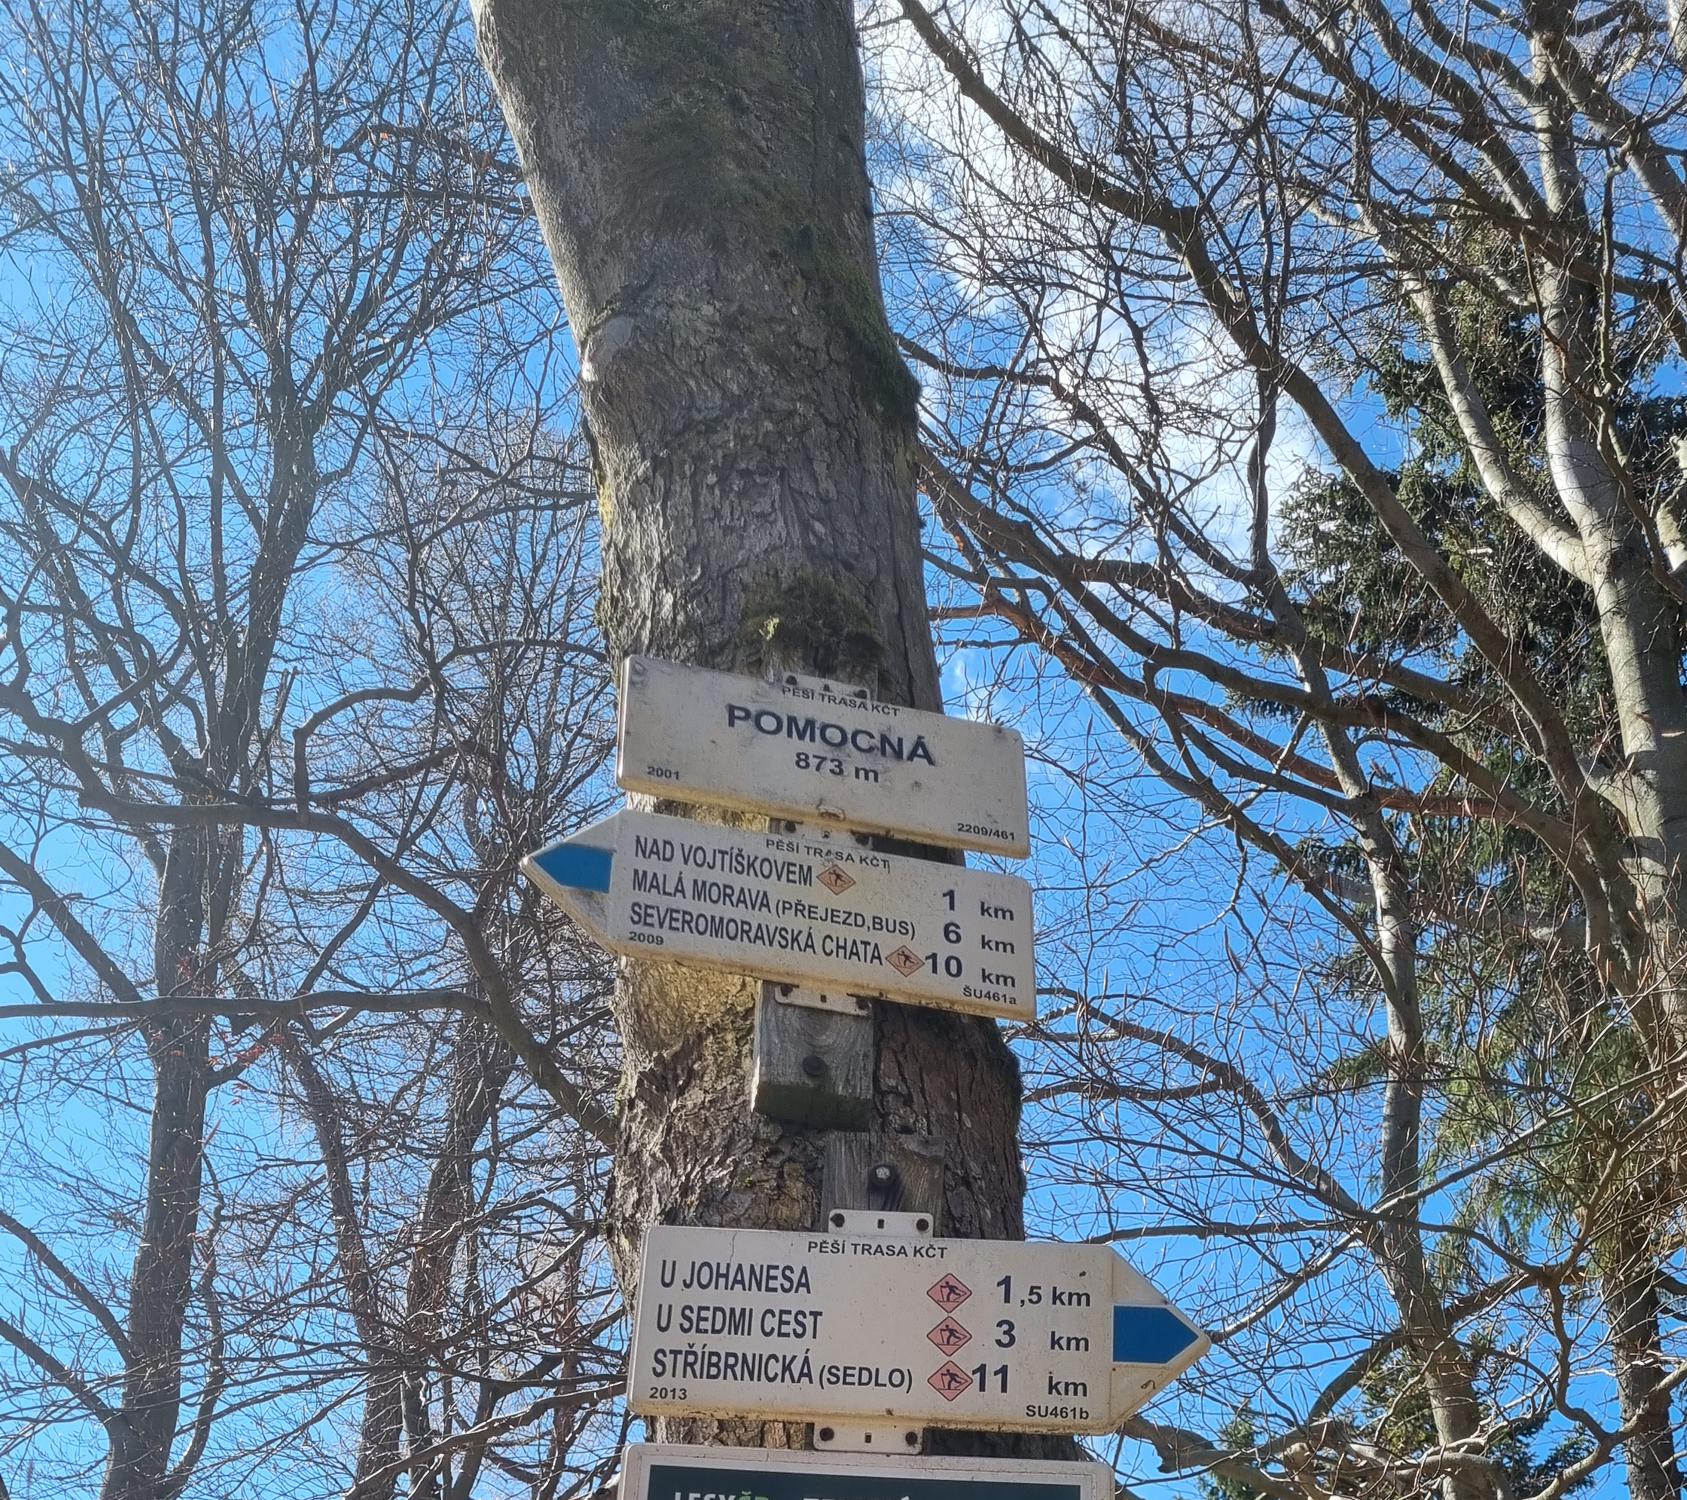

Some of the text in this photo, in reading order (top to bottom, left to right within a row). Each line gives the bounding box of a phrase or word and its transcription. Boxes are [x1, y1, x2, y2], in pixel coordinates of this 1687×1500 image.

[818, 691, 868, 713] TRASA
[870, 700, 900, 717] KČT
[726, 703, 936, 766] POMOCNÁ
[647, 766, 680, 780] 2001
[795, 752, 880, 783] 873 m
[957, 823, 1015, 841] 2209/461
[766, 838, 889, 870] PĚŠÍ TRASA KČT
[634, 835, 1014, 922] NAD VOJTÍŠKOVEM 1 km
[633, 868, 1015, 954] MALÁ MORAVA (PŘEJEZD,BUS) 6 km
[628, 931, 664, 946] 2009
[630, 902, 1016, 989] SEVEROMORAVSKÁ CHATA 10 km
[962, 985, 1017, 1005] ŠU461a
[807, 1238, 948, 1260] PĚŠÍ TRASA KČT
[661, 1260, 1090, 1309] U JOHANESA 1,5 km
[656, 1303, 1090, 1352] U SEDMI CEST 3 km
[652, 1343, 1088, 1397] STŘÍBRNICKÁ (SEDLO) 11 km
[649, 1387, 687, 1401] 2013
[1026, 1404, 1090, 1421] SU461b
